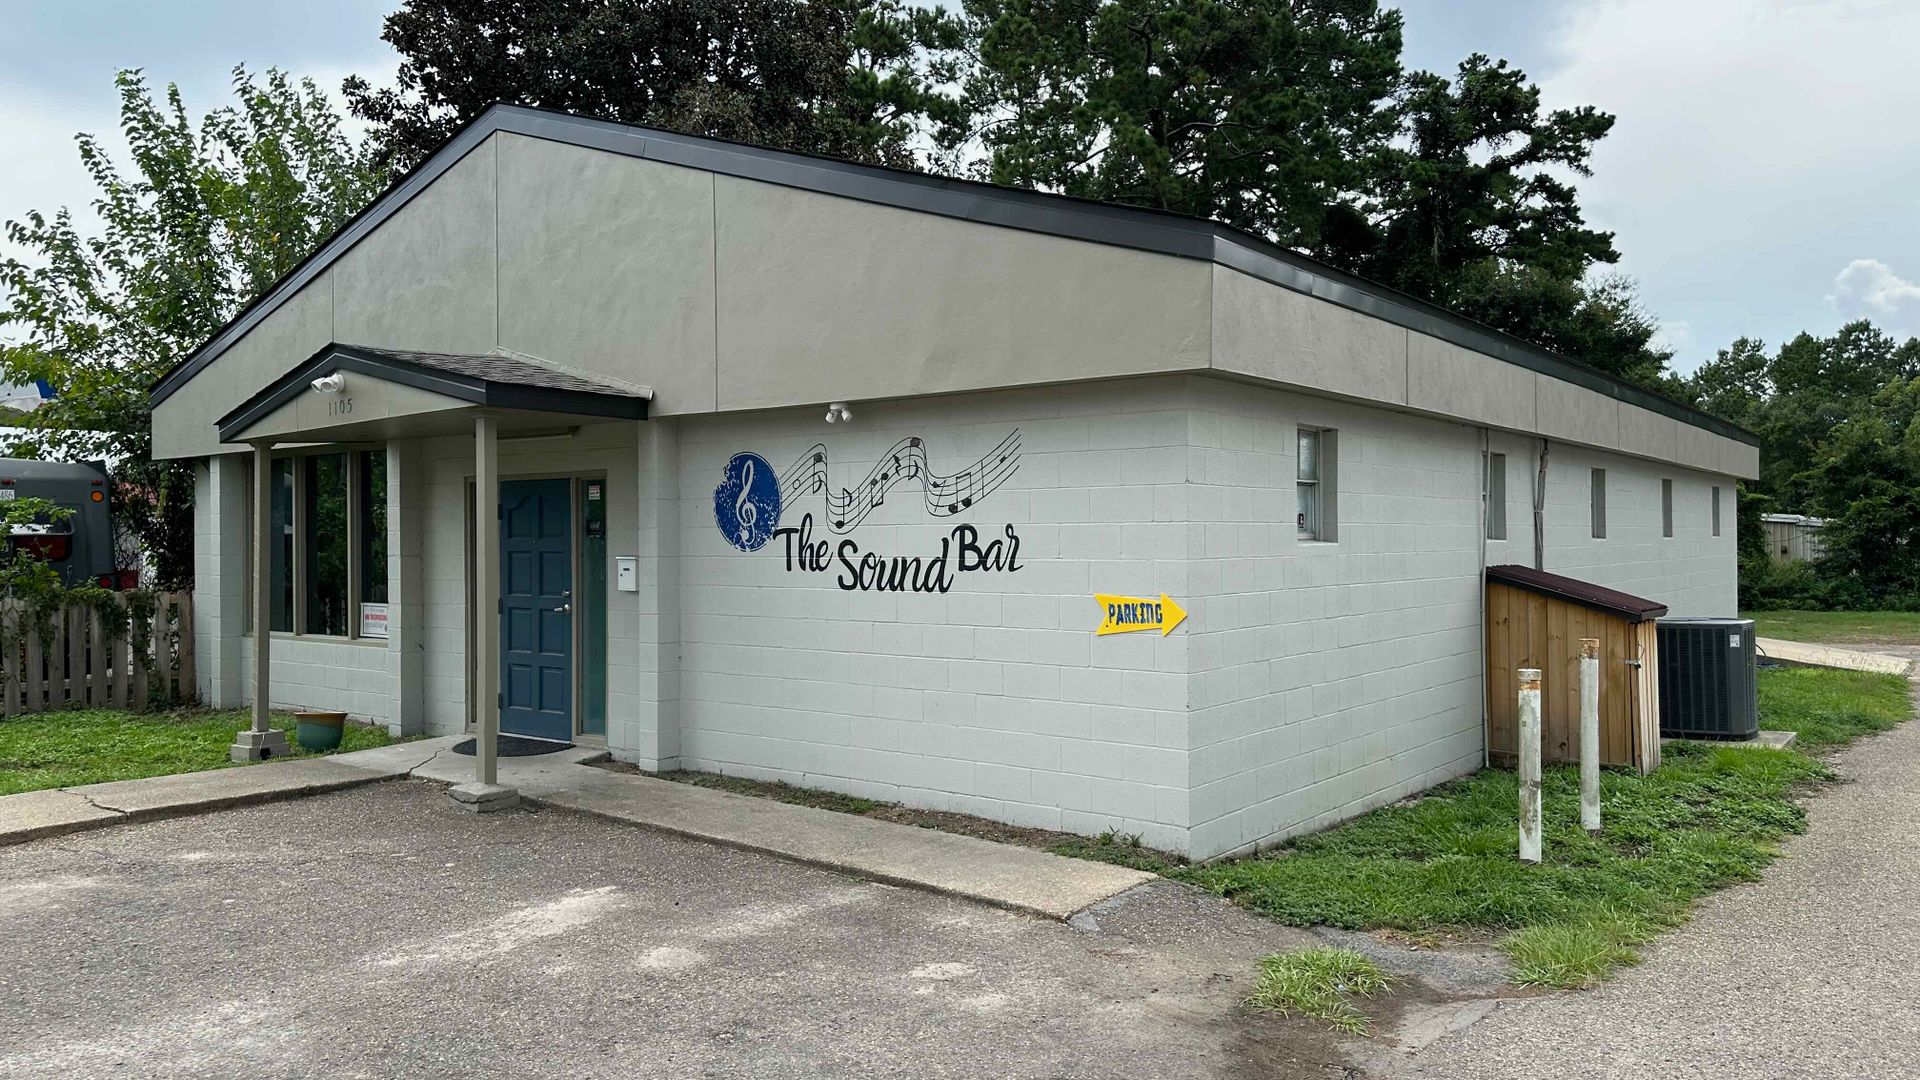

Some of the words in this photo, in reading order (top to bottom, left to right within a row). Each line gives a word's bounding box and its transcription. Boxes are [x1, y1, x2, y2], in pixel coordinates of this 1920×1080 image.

[329, 397, 352, 416] 1105
[773, 513, 833, 573] The
[837, 537, 953, 594] Sound
[952, 523, 1024, 572] Bar
[1108, 602, 1163, 625] PARKING
